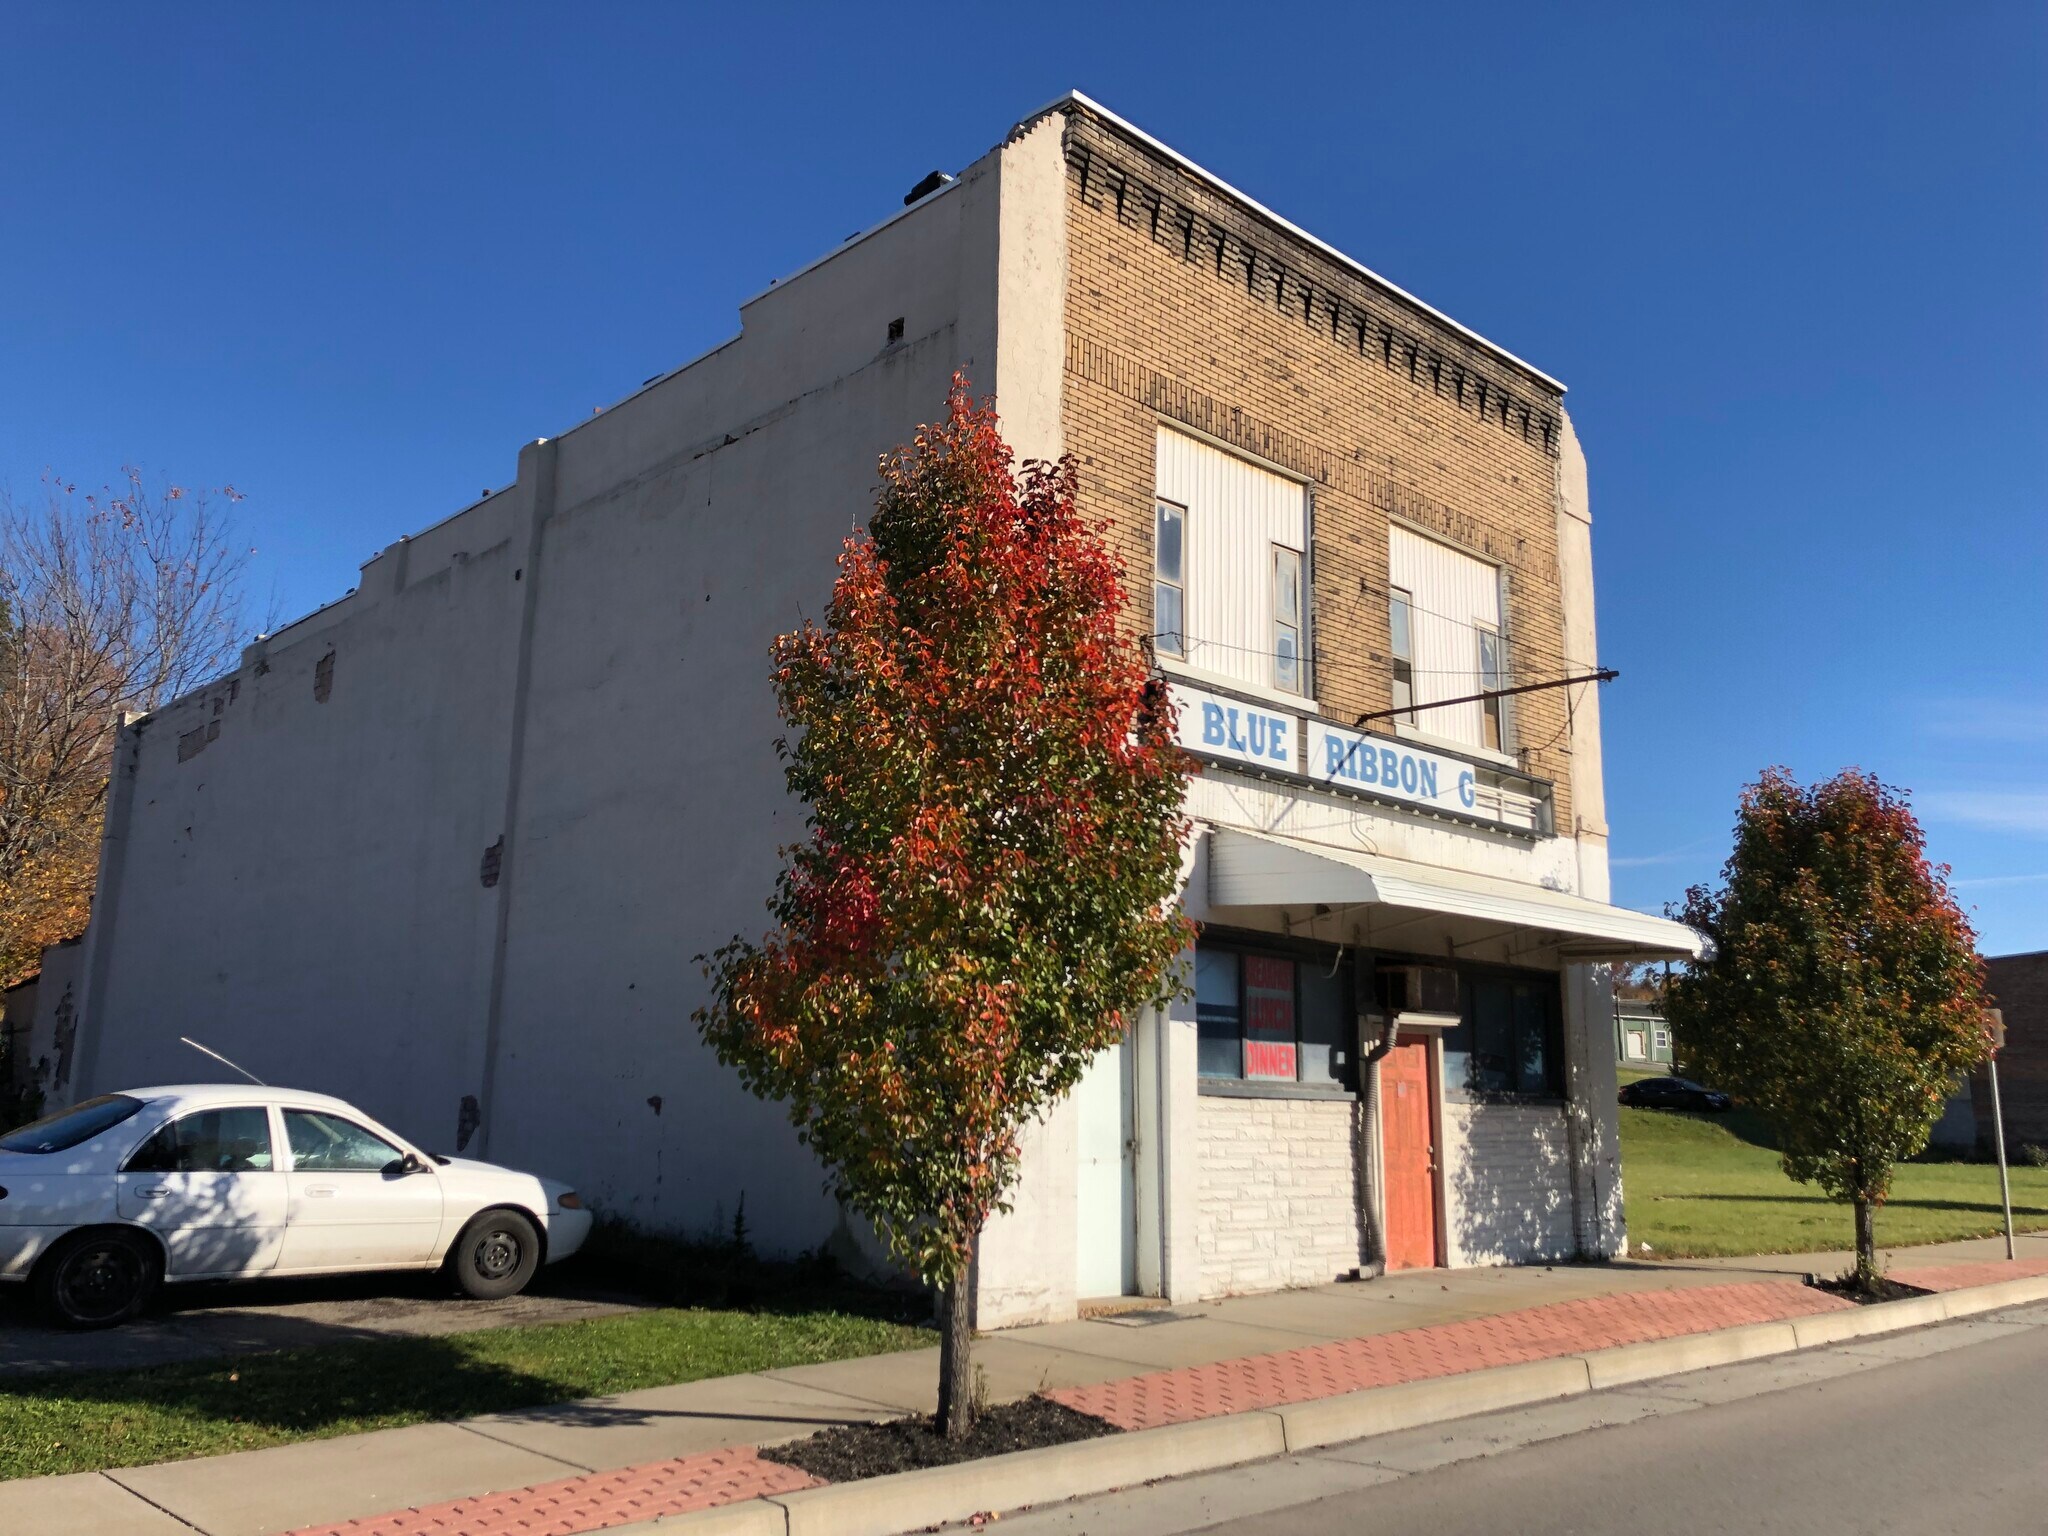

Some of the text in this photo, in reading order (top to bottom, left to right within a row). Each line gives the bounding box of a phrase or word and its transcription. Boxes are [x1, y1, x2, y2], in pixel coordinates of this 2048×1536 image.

[1202, 701, 1474, 808] BLUE RIBBON G
[1247, 1042, 1296, 1077] DINNER
